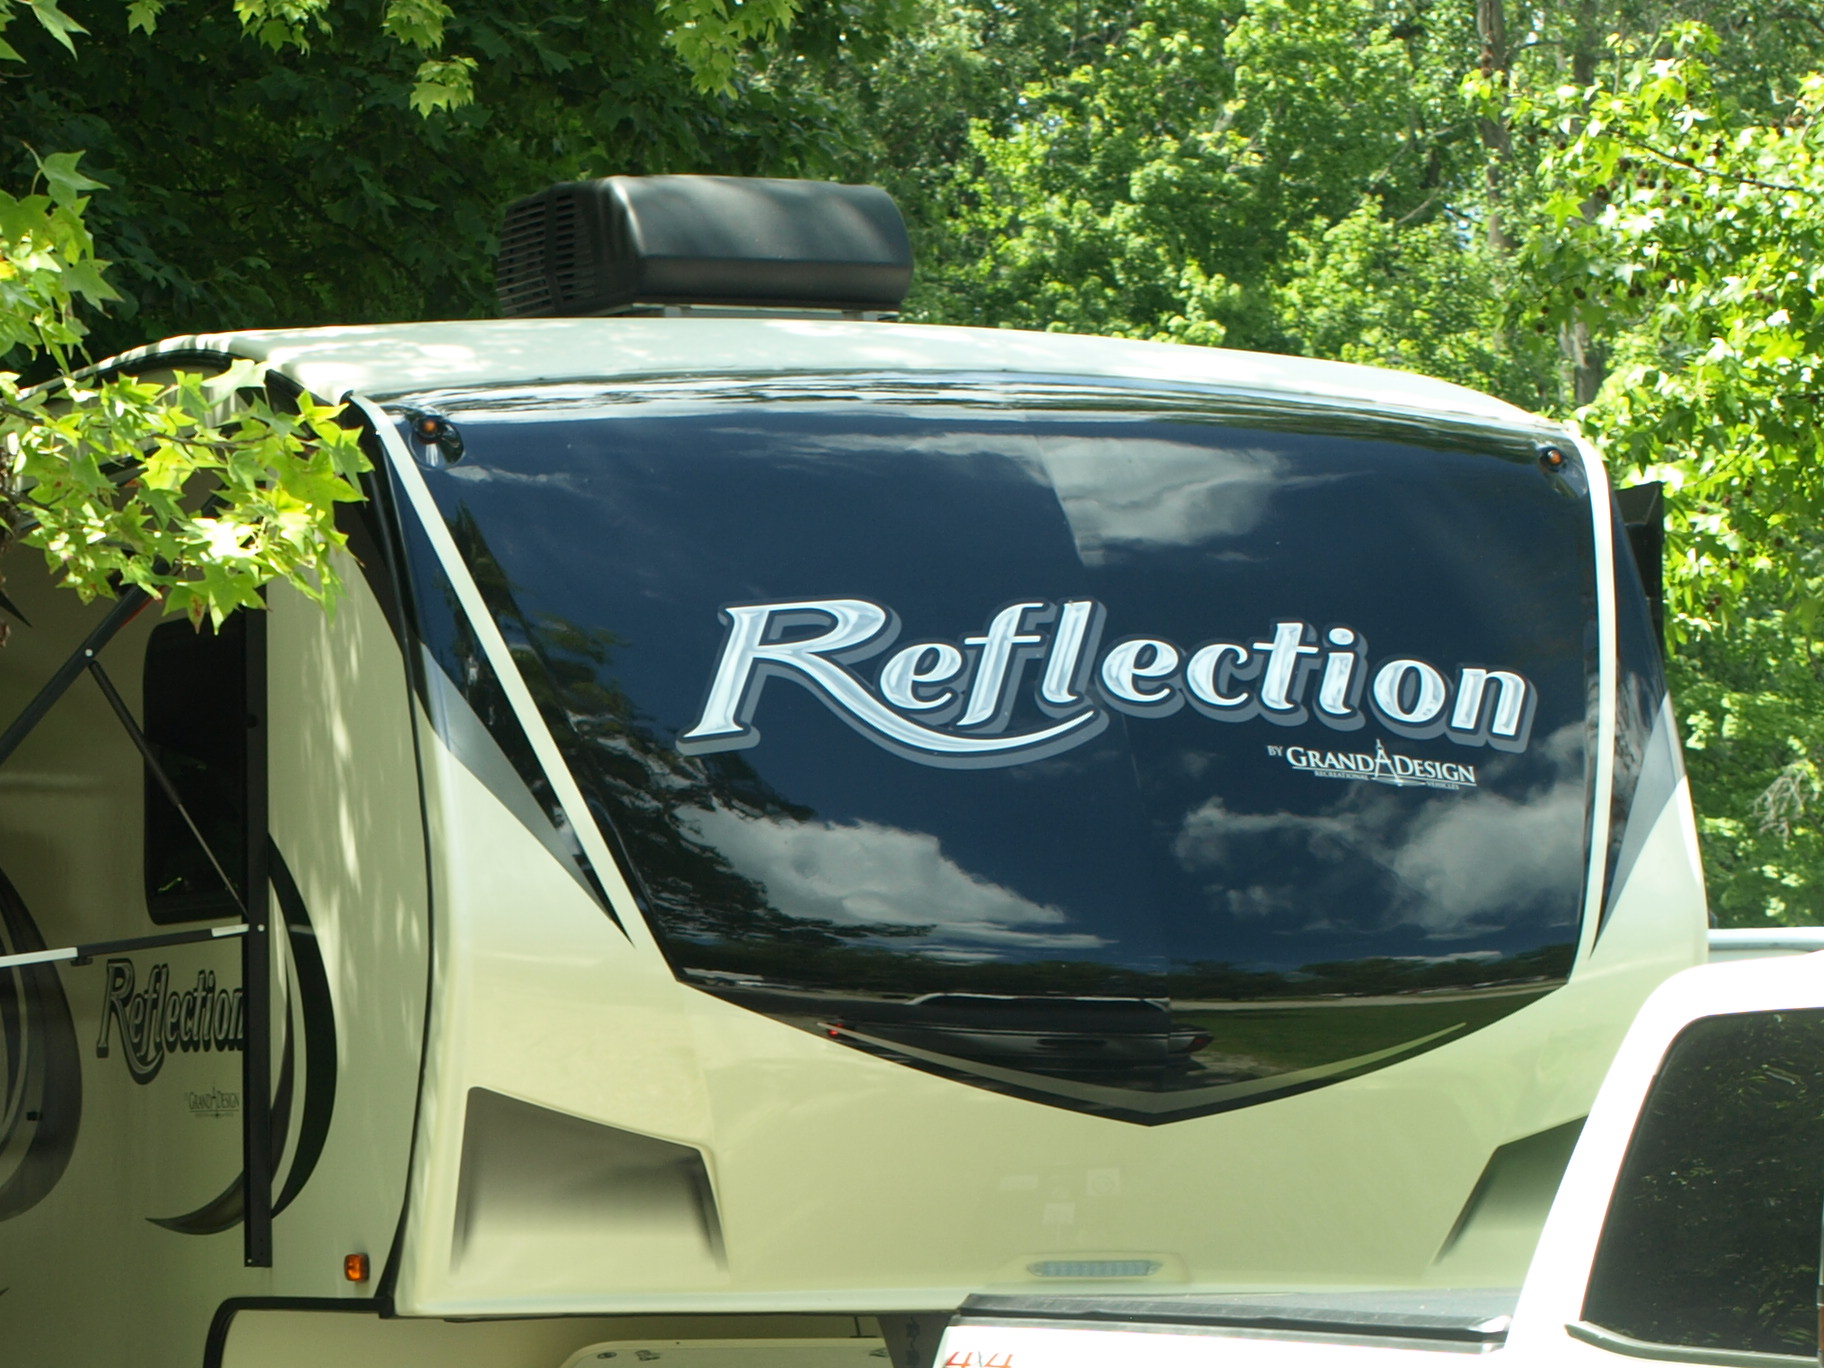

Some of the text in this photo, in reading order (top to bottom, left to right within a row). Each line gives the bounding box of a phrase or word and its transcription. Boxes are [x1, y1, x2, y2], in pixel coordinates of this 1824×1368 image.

[679, 597, 1534, 758] Reflection
[1266, 745, 1476, 784] BY GRAND DESIGN
[96, 958, 244, 1085] Reflection
